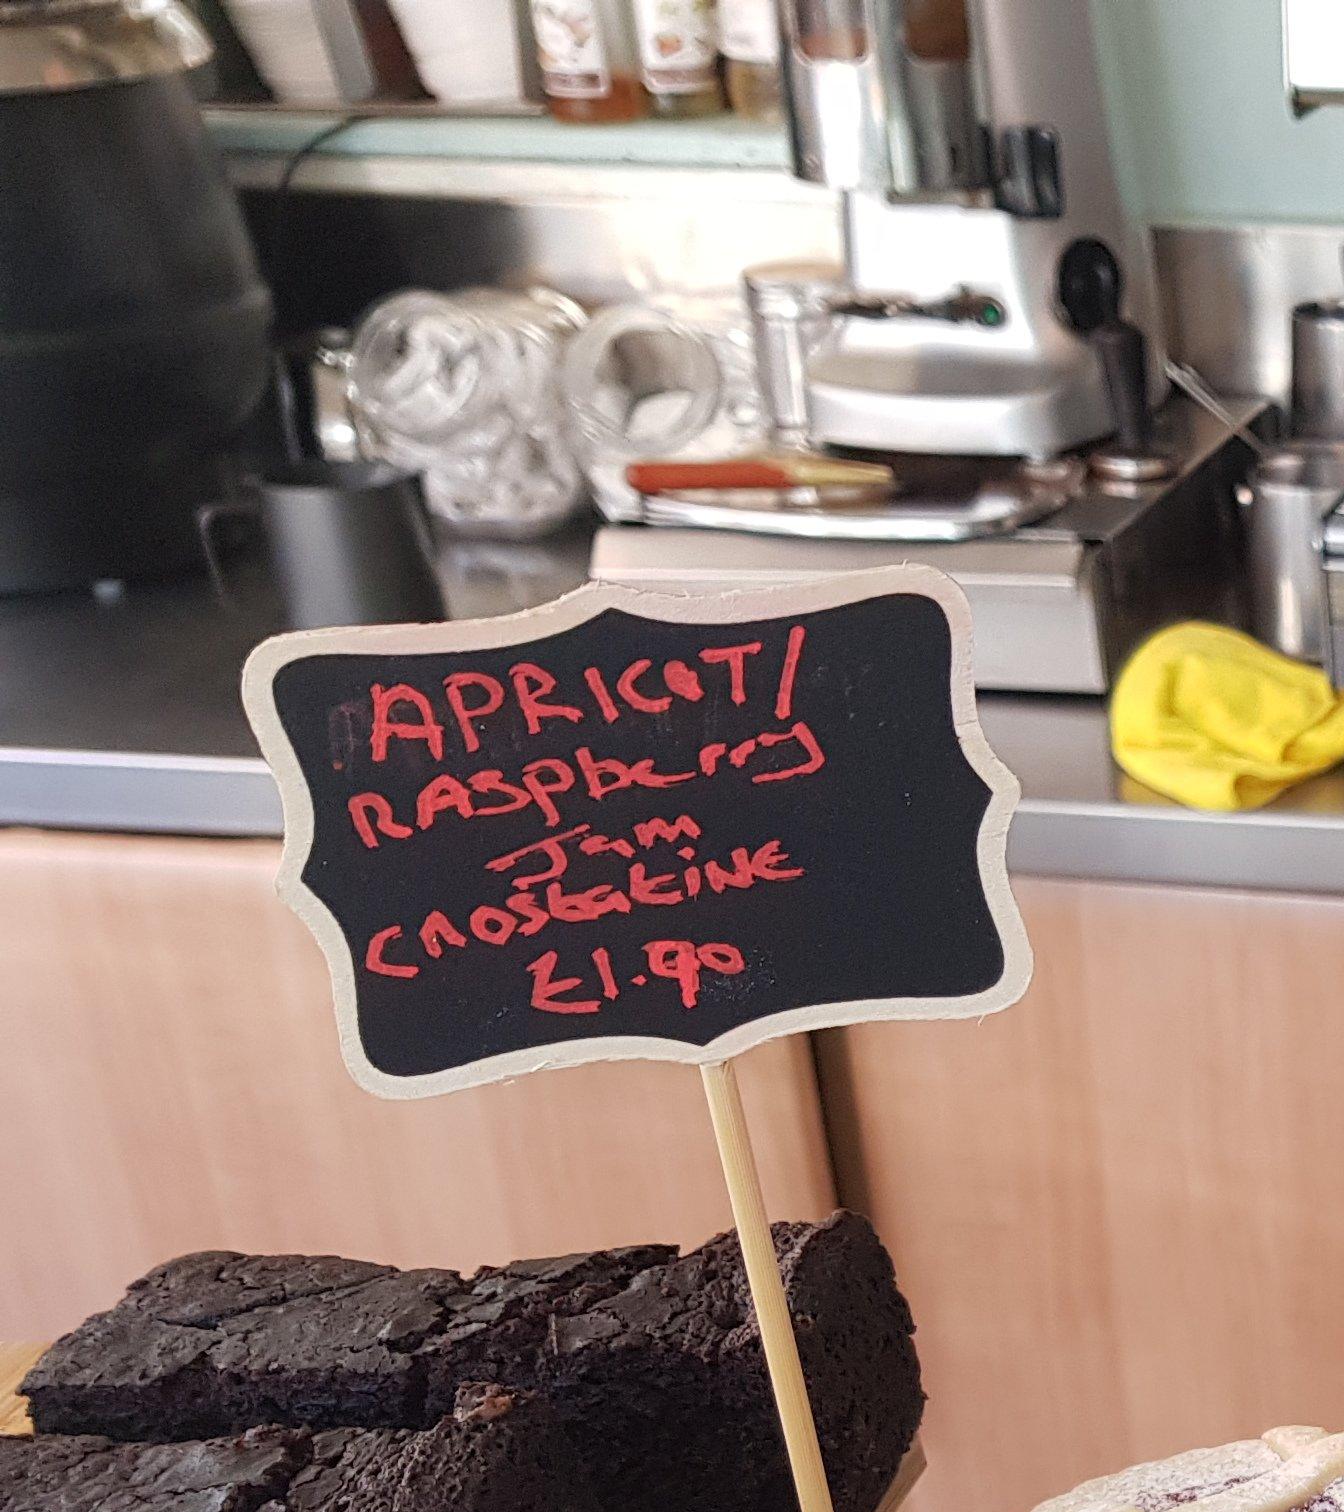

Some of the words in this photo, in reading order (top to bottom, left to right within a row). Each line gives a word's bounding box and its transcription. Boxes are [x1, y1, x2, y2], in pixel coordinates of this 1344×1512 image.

[370, 626, 806, 762] APRICOT/
[486, 814, 702, 889] Jam
[528, 939, 745, 1014] £1.90
